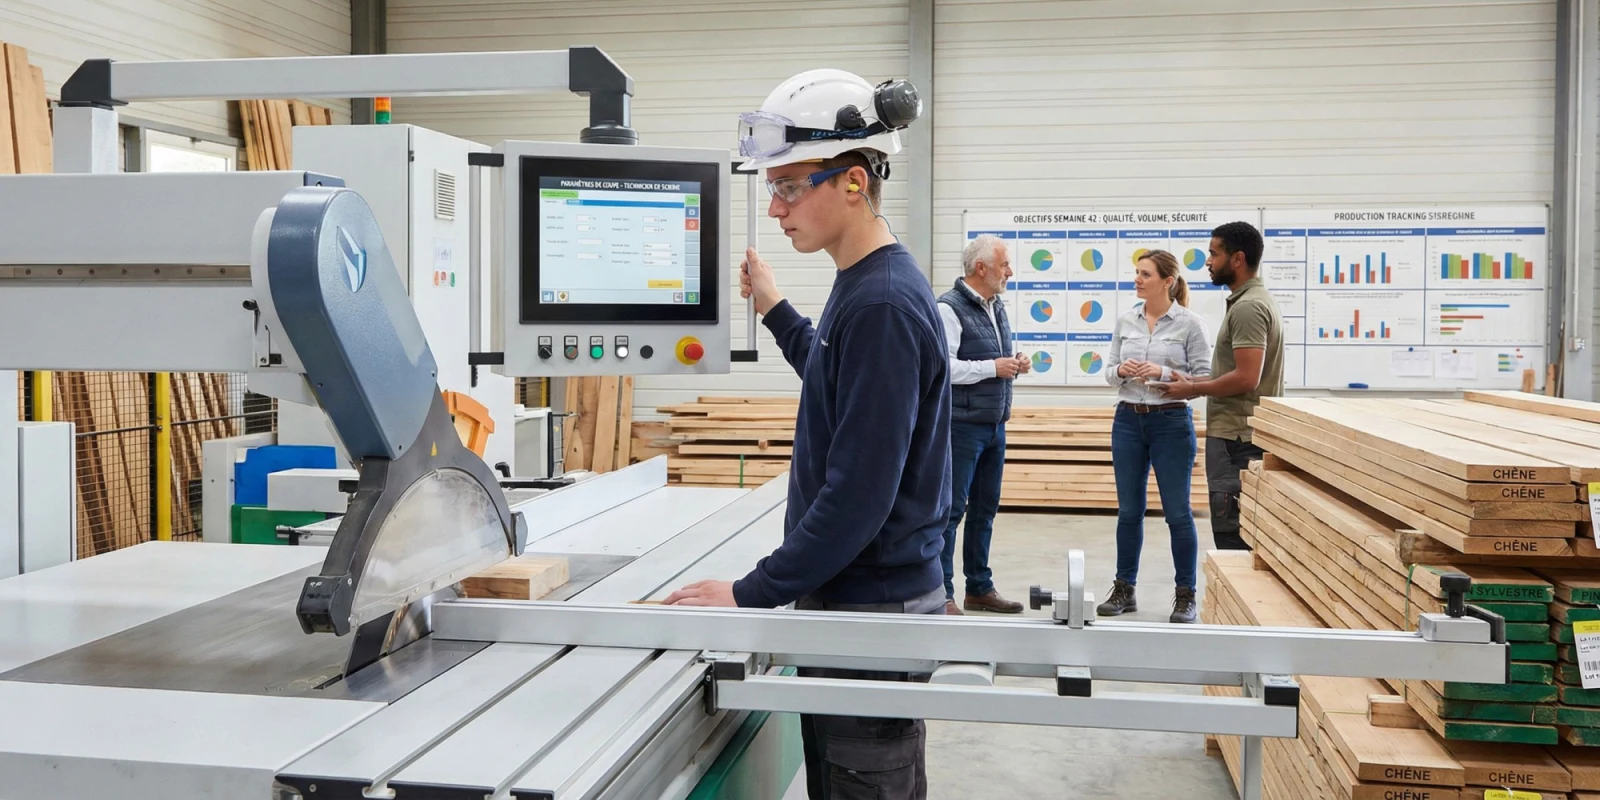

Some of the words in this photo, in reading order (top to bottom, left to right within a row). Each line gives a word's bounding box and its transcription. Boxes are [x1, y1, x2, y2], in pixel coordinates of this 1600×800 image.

[1013, 214, 1052, 223] OBJECTIFS
[1053, 214, 1087, 223] SEMAINE
[1088, 214, 1097, 223] 42
[1102, 212, 1136, 224] QUALITÉ,
[1137, 213, 1170, 223] VOLUME,
[1171, 212, 1208, 223] SÉCURITÉ
[1334, 212, 1385, 221] PRODUCTION
[1386, 212, 1427, 221] TRACKING
[1475, 586, 1545, 599] SYLVESTRE
